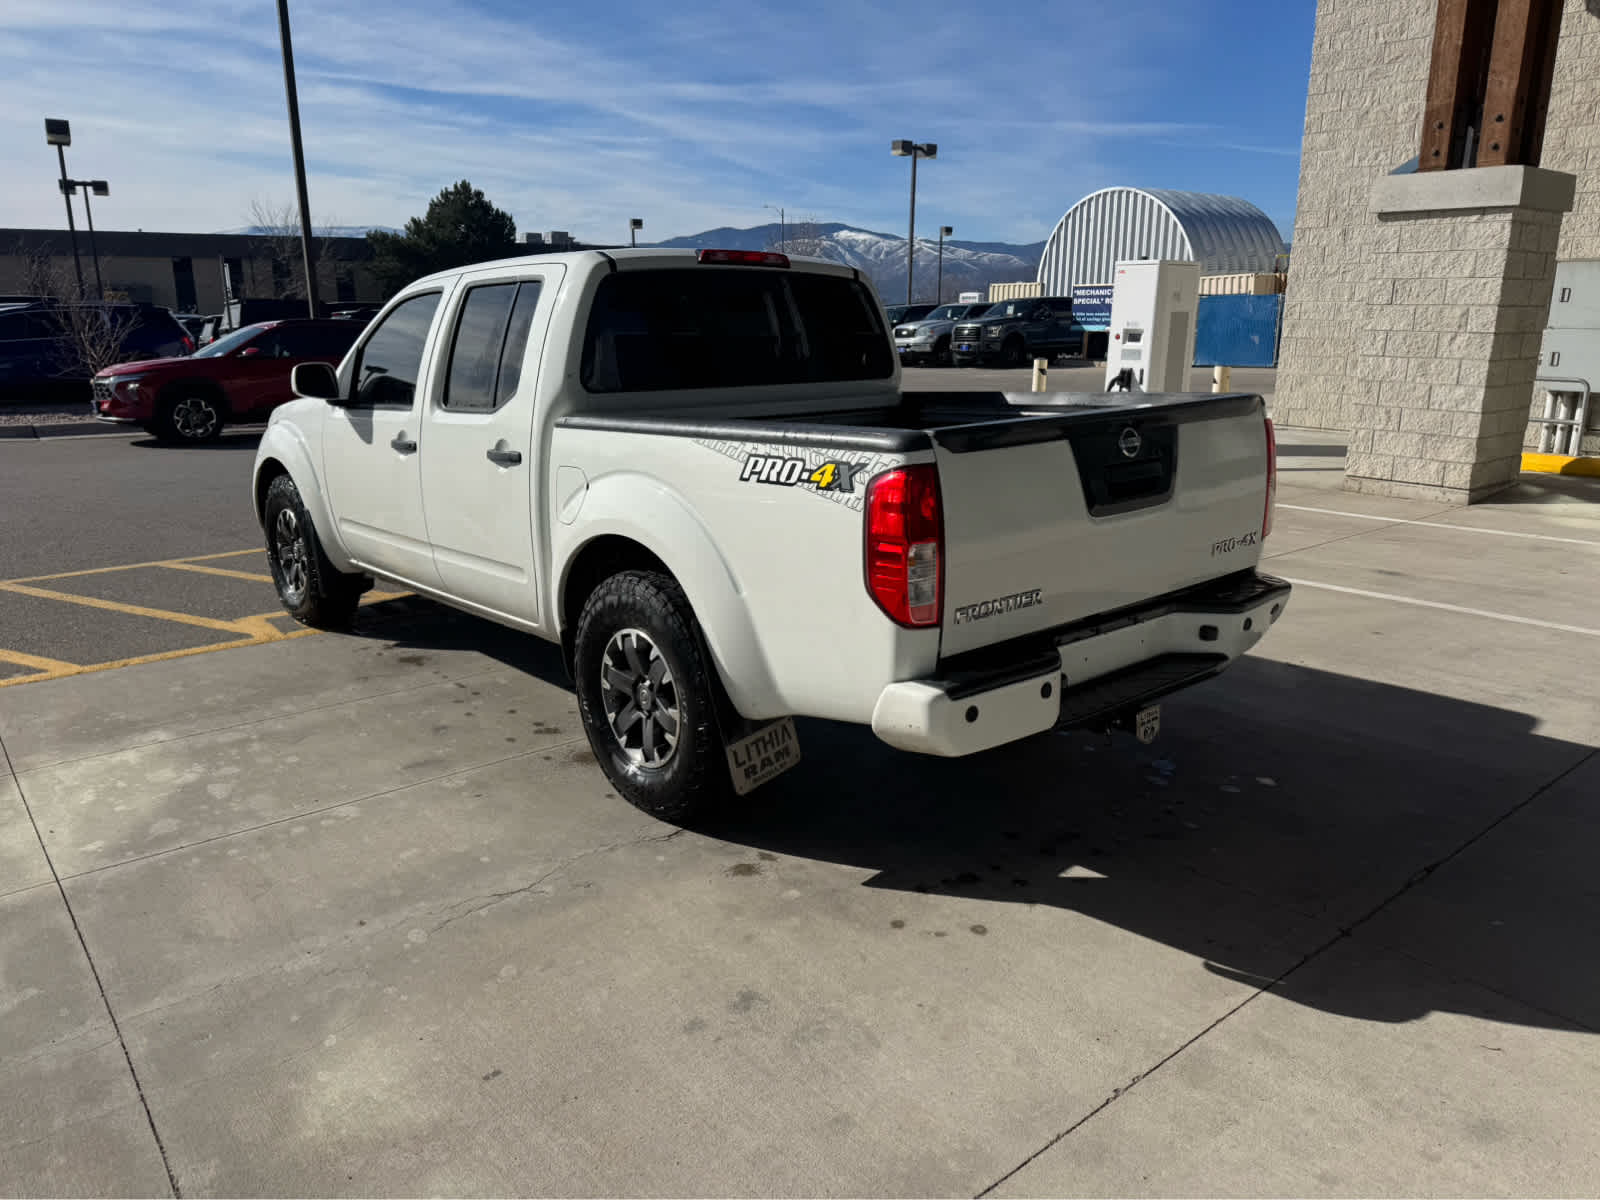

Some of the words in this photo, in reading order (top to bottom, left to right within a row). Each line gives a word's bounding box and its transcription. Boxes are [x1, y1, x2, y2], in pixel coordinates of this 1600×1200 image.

[739, 454, 868, 493] PRO-4X
[1211, 531, 1257, 558] PRO-4X
[953, 588, 1042, 625] FRONTIER
[730, 723, 792, 769] LITHIA
